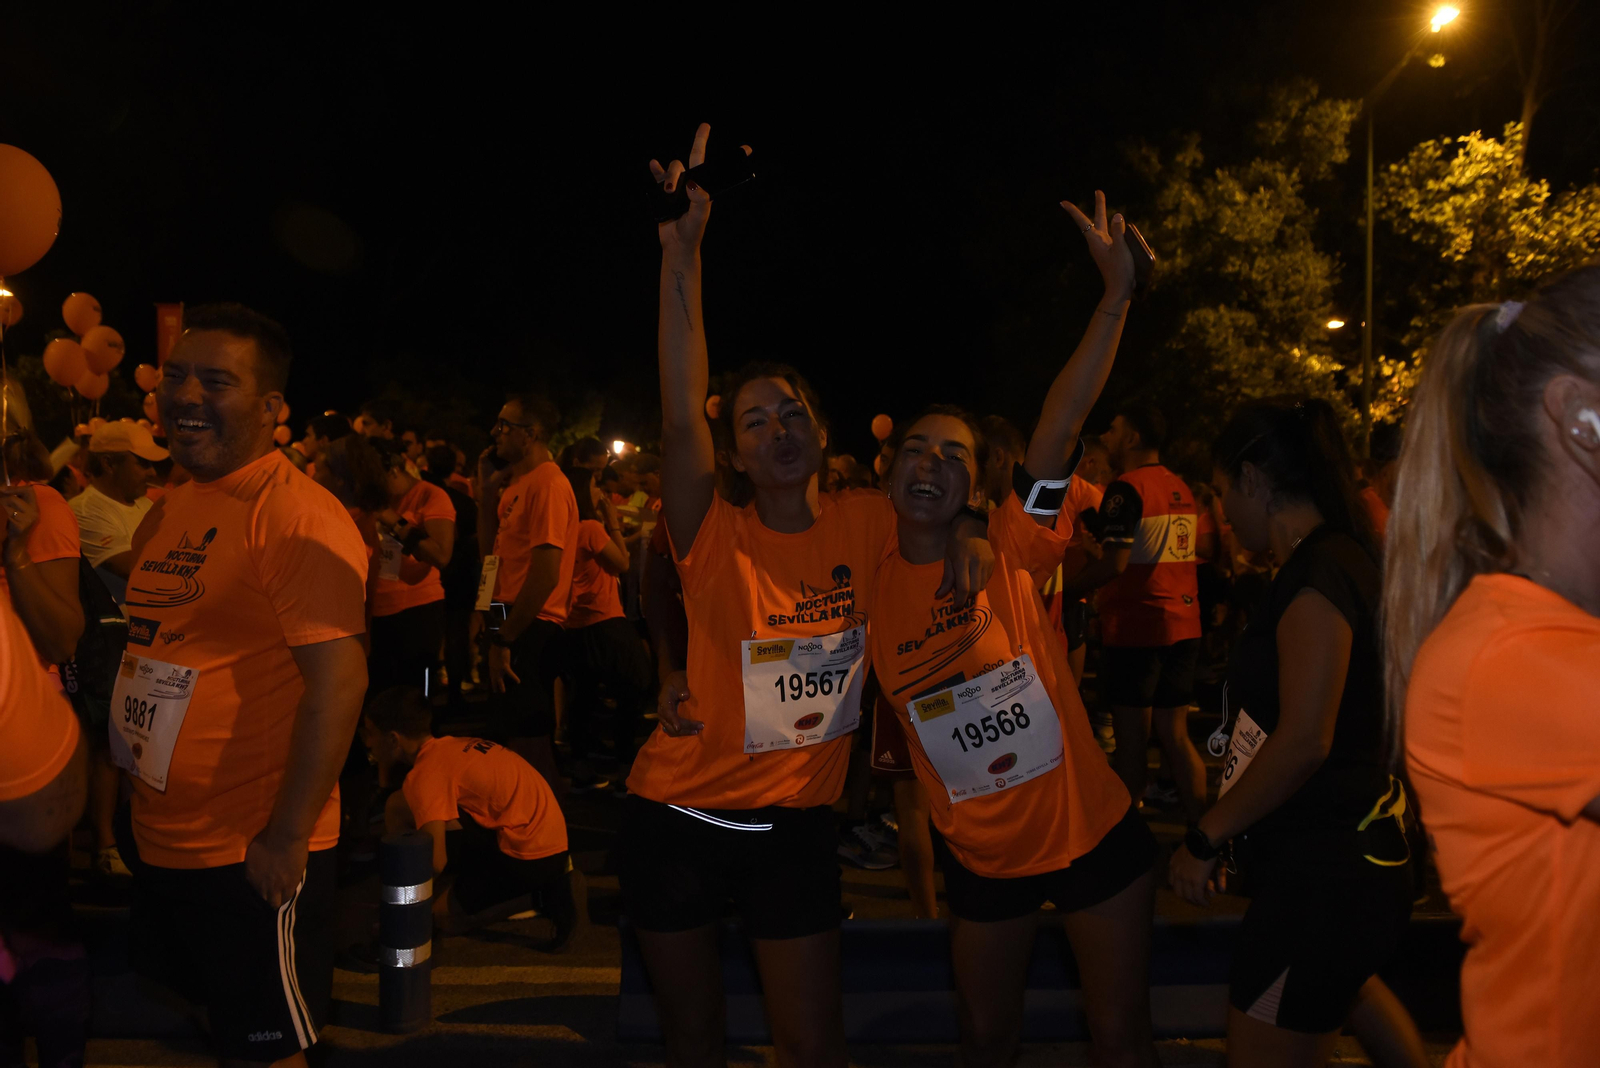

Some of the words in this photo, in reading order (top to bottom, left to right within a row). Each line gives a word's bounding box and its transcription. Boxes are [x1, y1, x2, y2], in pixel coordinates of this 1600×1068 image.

[165, 550, 207, 564] NOCTURNA
[140, 560, 179, 576] SEVILLA
[177, 564, 202, 579] KH7
[768, 610, 829, 626] SEVILLA
[829, 646, 850, 655] SEVILLA
[991, 679, 1014, 693] SEVILLA
[1014, 671, 1026, 681] KH7
[1000, 668, 1025, 683] NOCTURNA
[156, 679, 175, 688] SEVILLA
[775, 669, 849, 702] 19567
[124, 695, 157, 731] 9881
[797, 716, 819, 727] KH7
[952, 703, 1030, 752] 19568
[991, 757, 1013, 771] KH7
[248, 1030, 283, 1042] adidas
